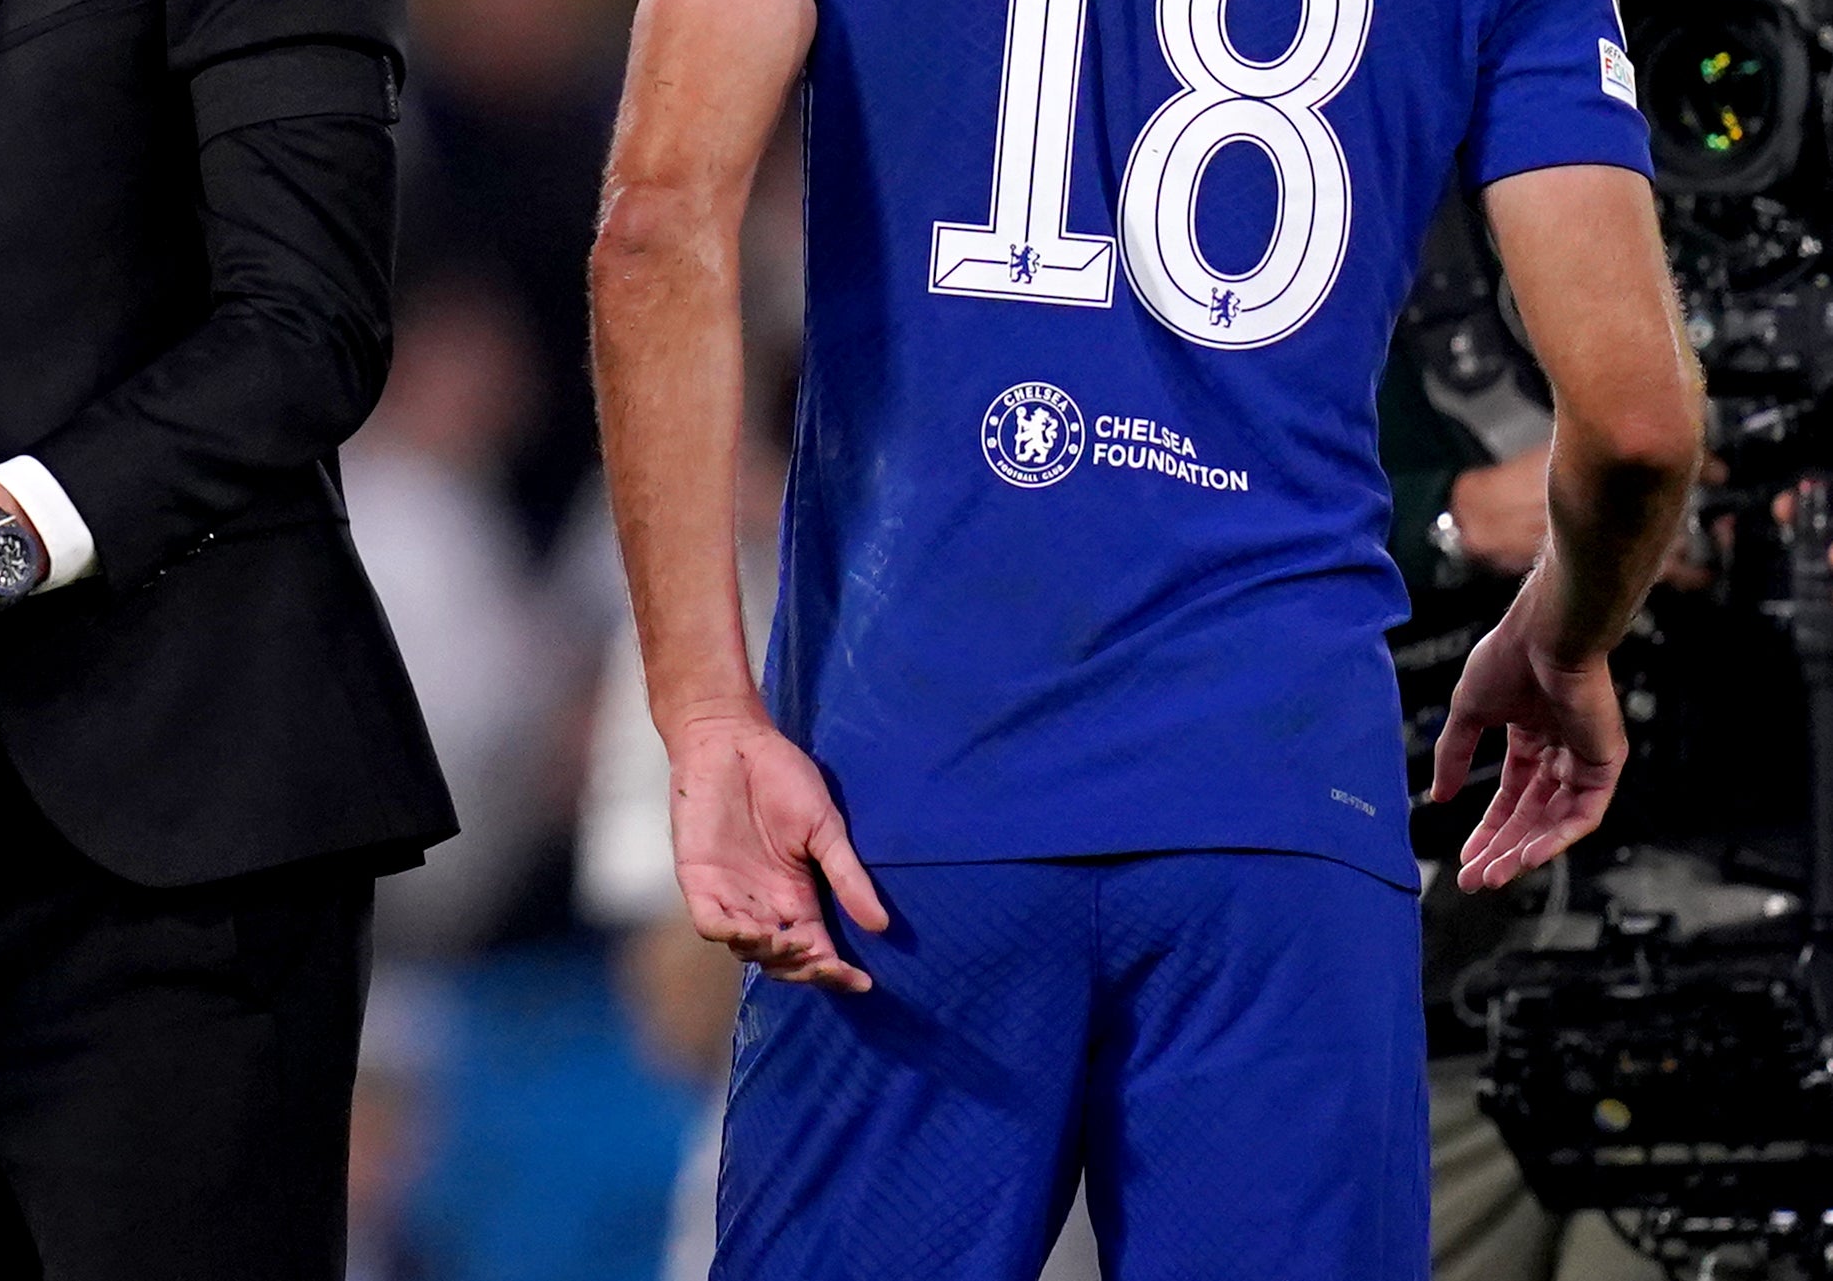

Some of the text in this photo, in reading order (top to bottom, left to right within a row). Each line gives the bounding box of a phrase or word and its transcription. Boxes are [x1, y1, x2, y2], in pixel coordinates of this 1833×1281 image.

[1003, 386, 1069, 412] CHELSEA
[1094, 416, 1197, 460] CHELSEA
[997, 460, 1065, 482] FOOTBALL CLUB
[1093, 443, 1249, 491] FOUNDATION
